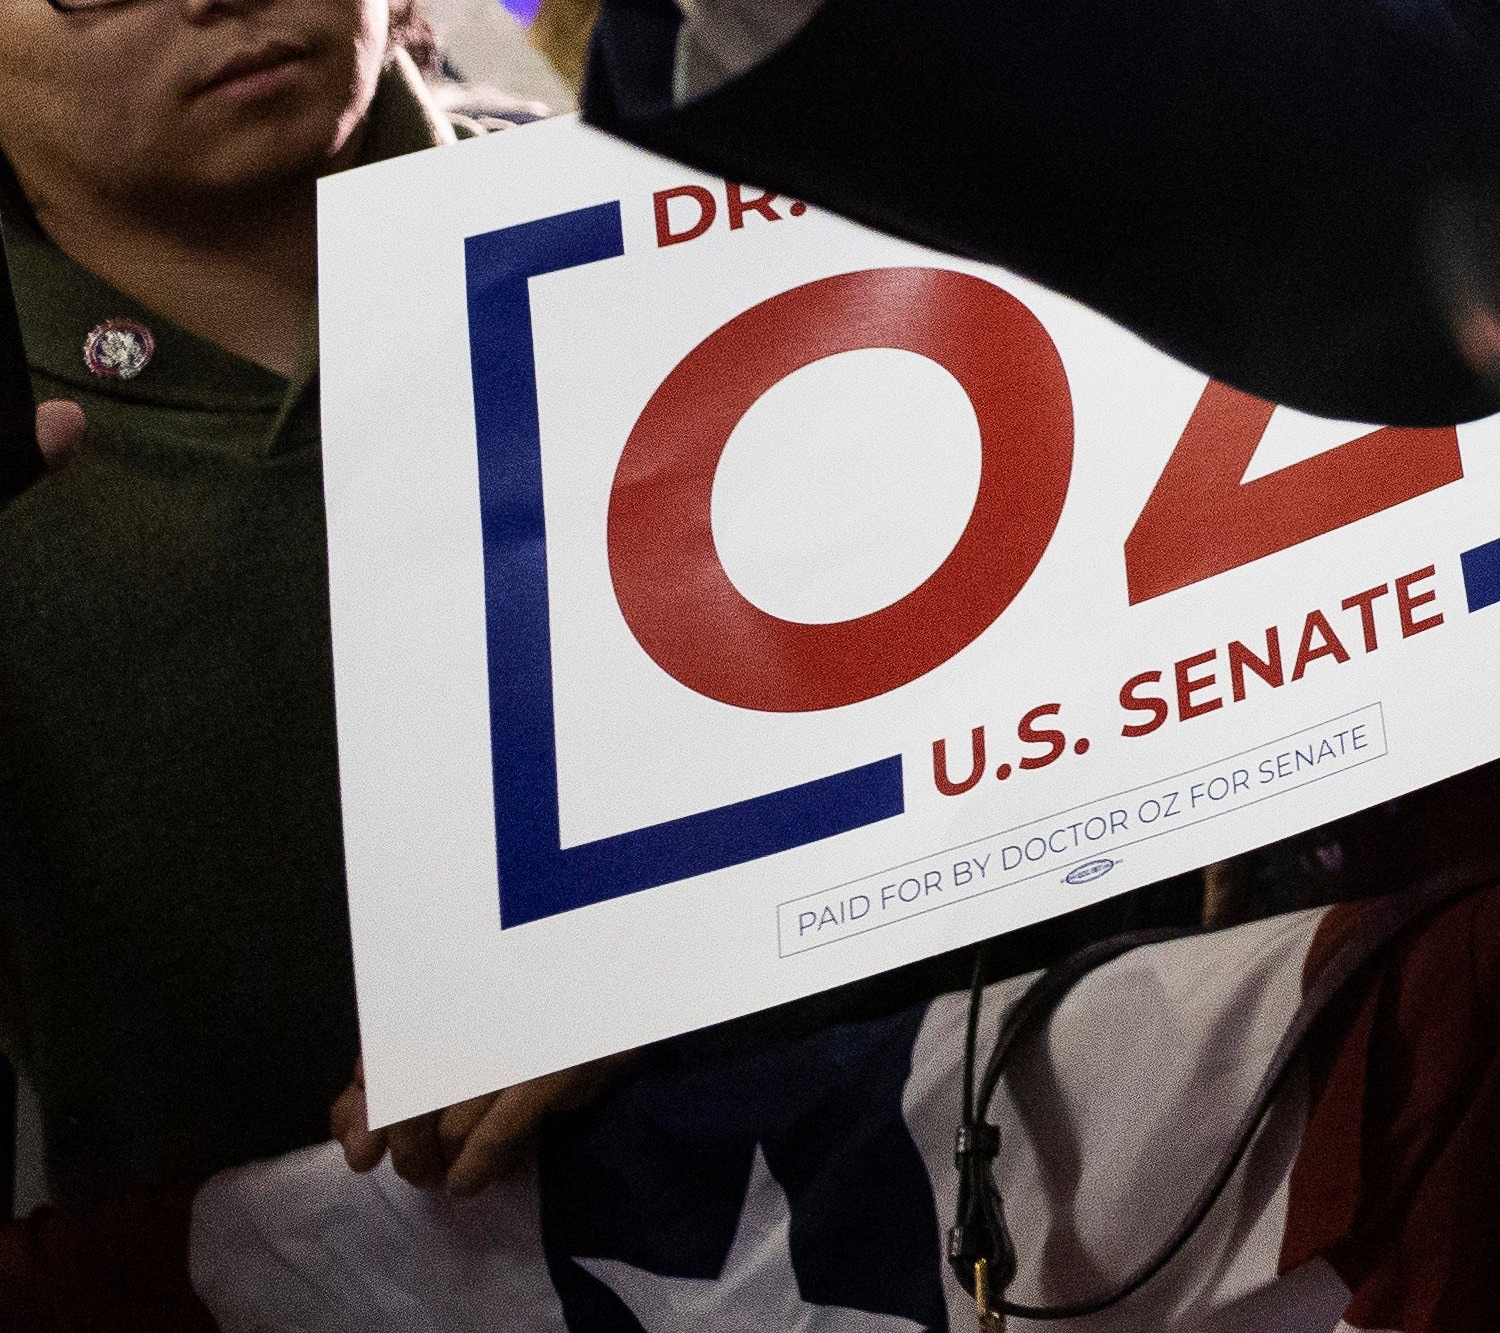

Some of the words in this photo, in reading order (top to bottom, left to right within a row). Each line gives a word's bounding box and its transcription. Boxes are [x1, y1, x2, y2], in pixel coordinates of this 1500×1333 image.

[652, 179, 807, 248] DR.
[932, 702, 1090, 797] U.S.
[1118, 563, 1444, 739] SENATE
[798, 894, 870, 937] PAID
[881, 870, 943, 910] FOR
[953, 852, 991, 887] BY
[1001, 808, 1130, 872] DOCTOR
[1138, 791, 1182, 824] OZ
[1191, 767, 1250, 809] FOR
[1258, 723, 1369, 785] SENATE
